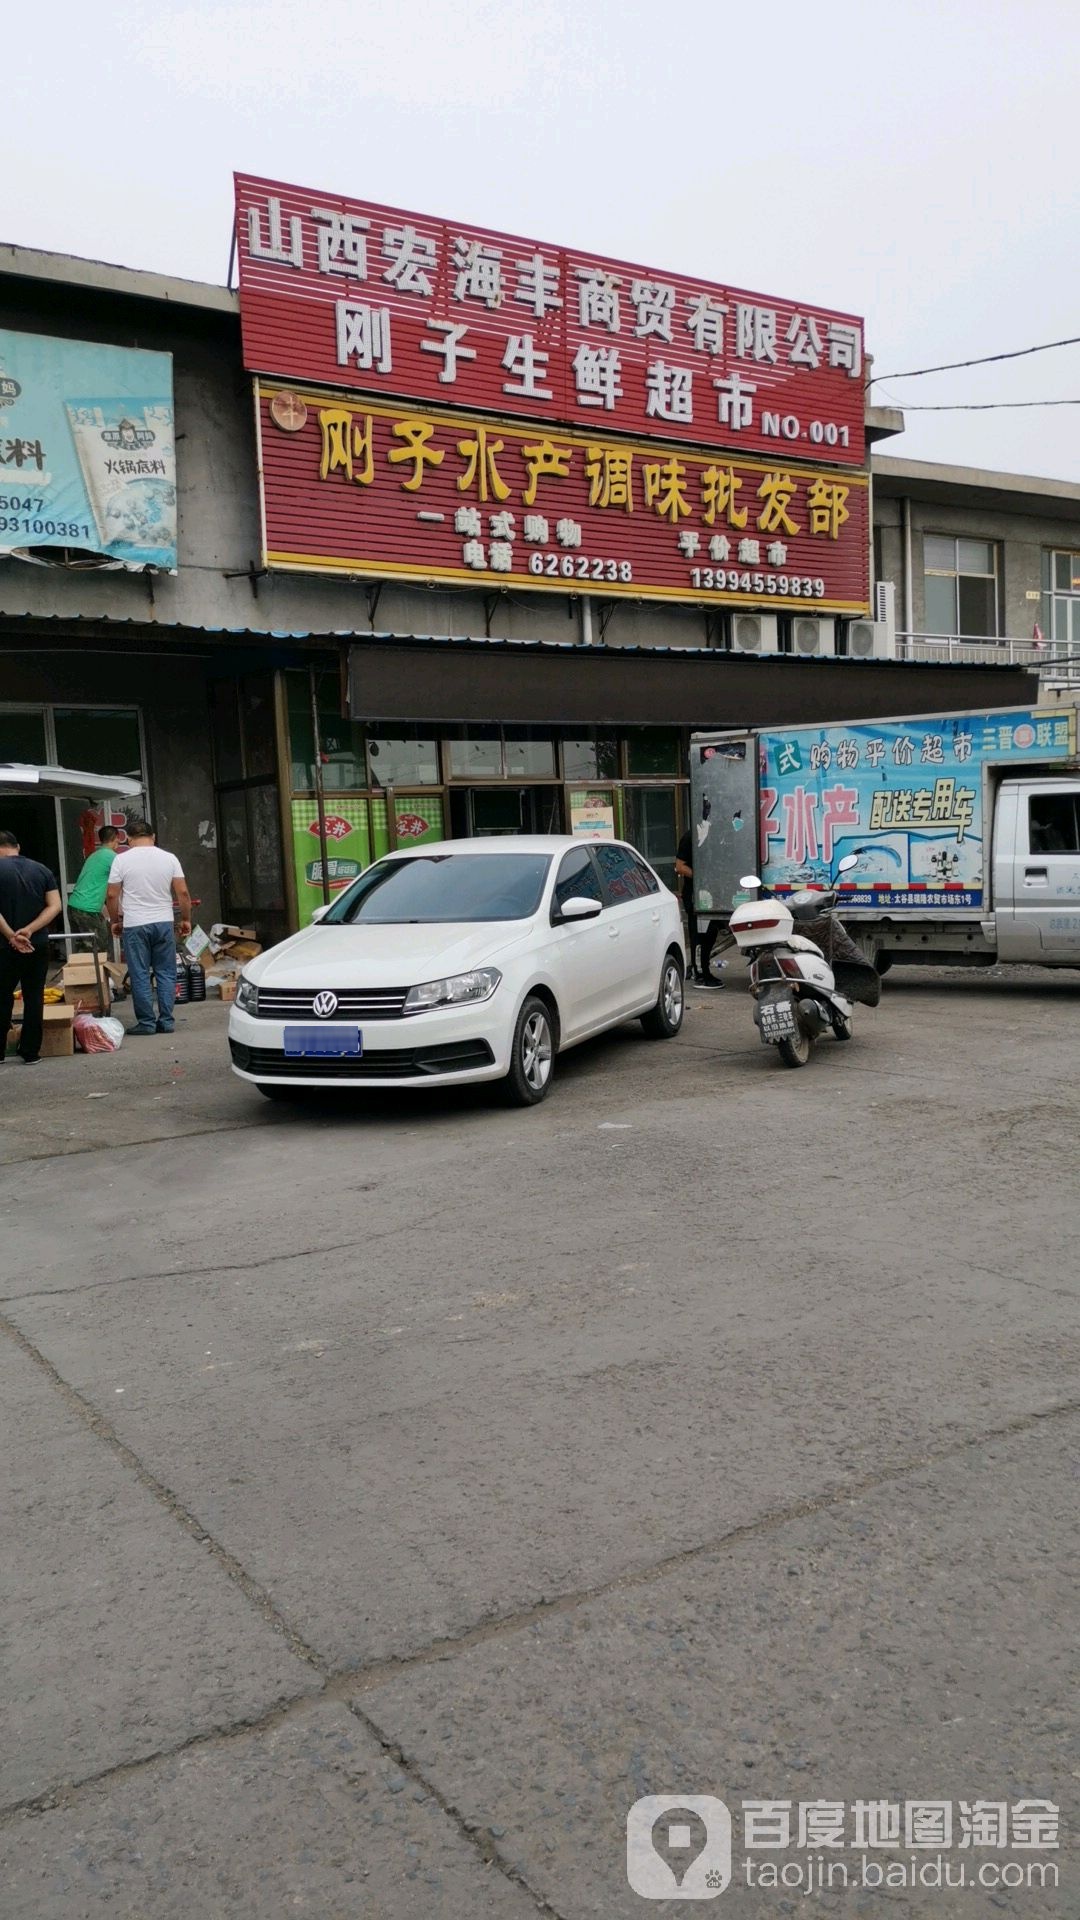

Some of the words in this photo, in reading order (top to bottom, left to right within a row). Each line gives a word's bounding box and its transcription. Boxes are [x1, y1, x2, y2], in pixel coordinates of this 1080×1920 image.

[247, 197, 862, 379] 山西宏海丰商贸有限公司
[335, 299, 757, 431] 刚子生鲜超市
[761, 411, 850, 448] NO.001
[0, 438, 46, 471] 料
[104, 459, 166, 475] 火锅底料
[319, 408, 851, 540] 刚子水产调味批发部
[417, 506, 582, 548] 一站式购物
[463, 539, 513, 572] 电话
[529, 552, 633, 583] 6262238
[677, 531, 788, 567] 平价超市
[690, 567, 825, 598] 13994559839
[760, 732, 973, 773] 式购物平价超市
[870, 777, 976, 844] 配送专用车
